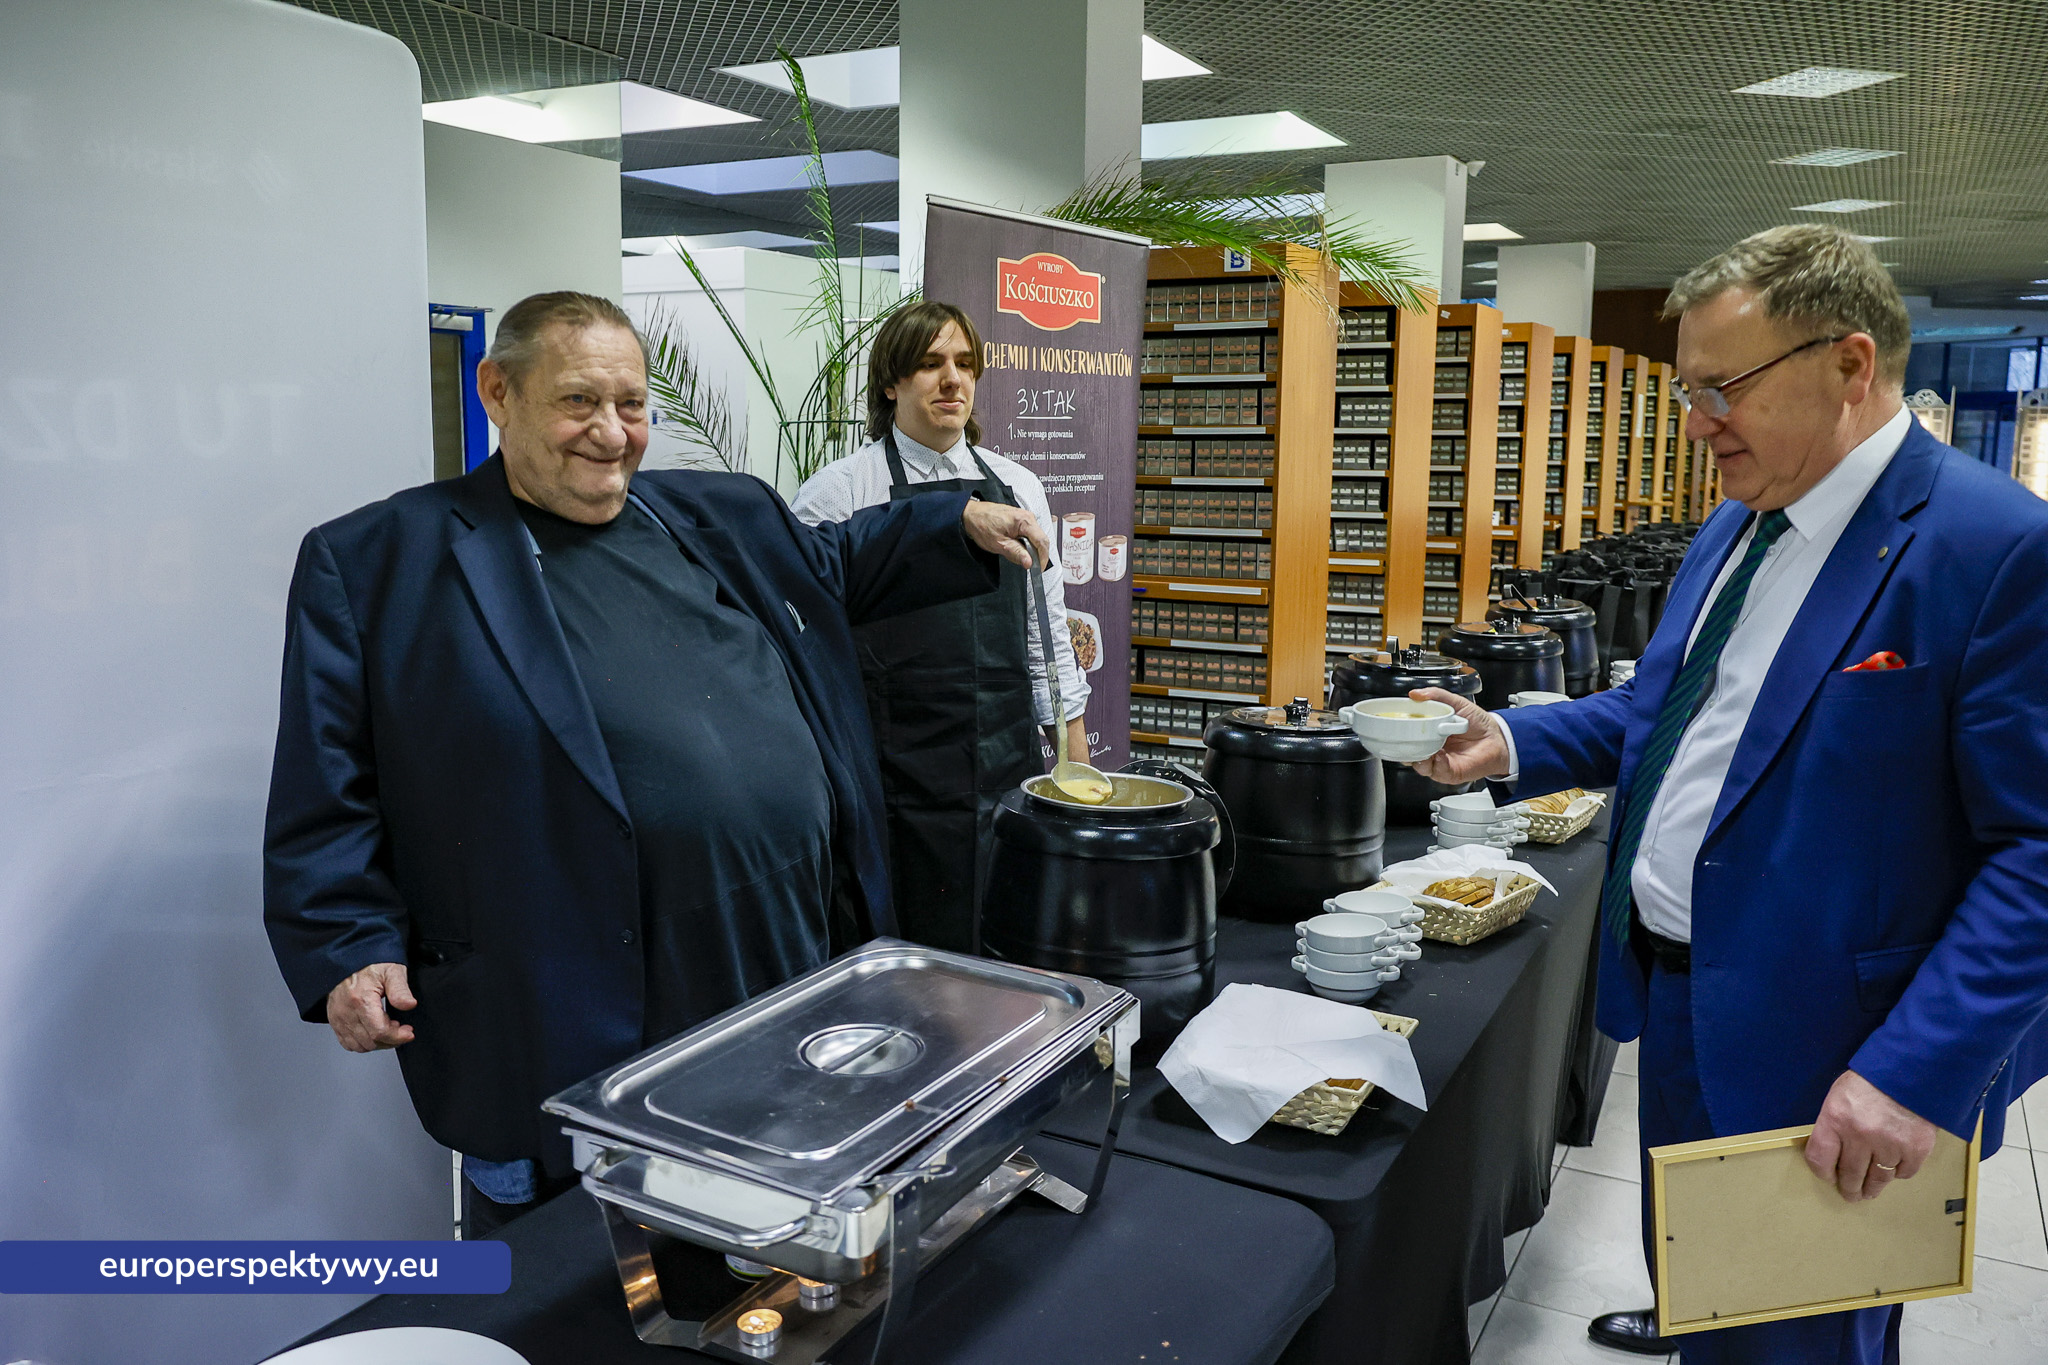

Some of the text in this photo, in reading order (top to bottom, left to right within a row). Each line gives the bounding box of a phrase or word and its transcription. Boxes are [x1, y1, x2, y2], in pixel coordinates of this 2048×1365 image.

[1037, 261, 1064, 274] WYROBY
[983, 341, 1134, 378] CHEMII I KONSERWANTÓW
[1042, 387, 1077, 417] TAK
[1017, 429, 1027, 439] Nie
[1028, 430, 1048, 441] wymaga
[1048, 429, 1074, 441] gotowania
[1003, 451, 1021, 463] Wolny
[1021, 452, 1029, 460] od
[1030, 451, 1046, 460] chemii
[1049, 450, 1087, 460] konserwantów
[1066, 471, 1104, 484] przygotowaniu
[1052, 483, 1074, 495] polskich
[1074, 484, 1096, 494] receptur
